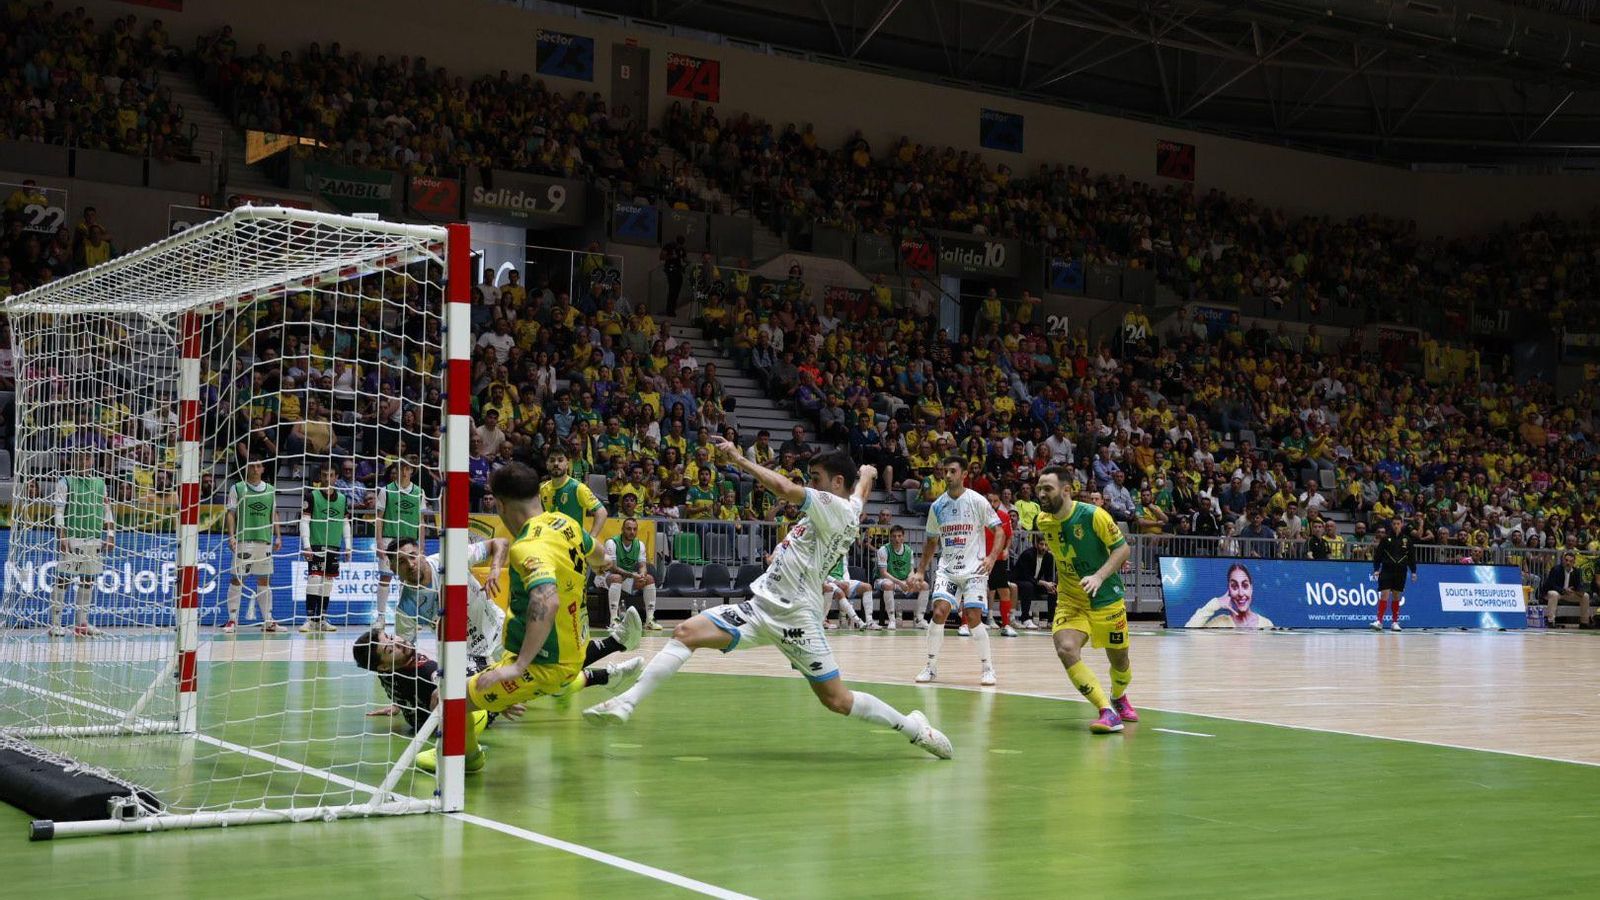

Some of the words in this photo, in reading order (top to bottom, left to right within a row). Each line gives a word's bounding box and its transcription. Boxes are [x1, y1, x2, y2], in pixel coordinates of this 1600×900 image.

[536, 30, 573, 46] Sector
[666, 53, 701, 68] Sector
[669, 60, 720, 102] 24
[411, 176, 440, 189] Sector
[472, 185, 537, 210] Salida
[547, 184, 567, 213] 9
[616, 201, 642, 213] Sector
[23, 204, 65, 234] 22
[984, 241, 1006, 268] 10
[824, 286, 861, 302] Sector
[1046, 315, 1069, 338] 24
[1125, 324, 1146, 341] 24
[338, 583, 358, 594] SIN
[1305, 582, 1405, 606] NOsolo
[1445, 588, 1473, 597] SOLICITA
[1474, 589, 1516, 597] PRESUPUESTO
[1474, 599, 1517, 607] COMPROMISO
